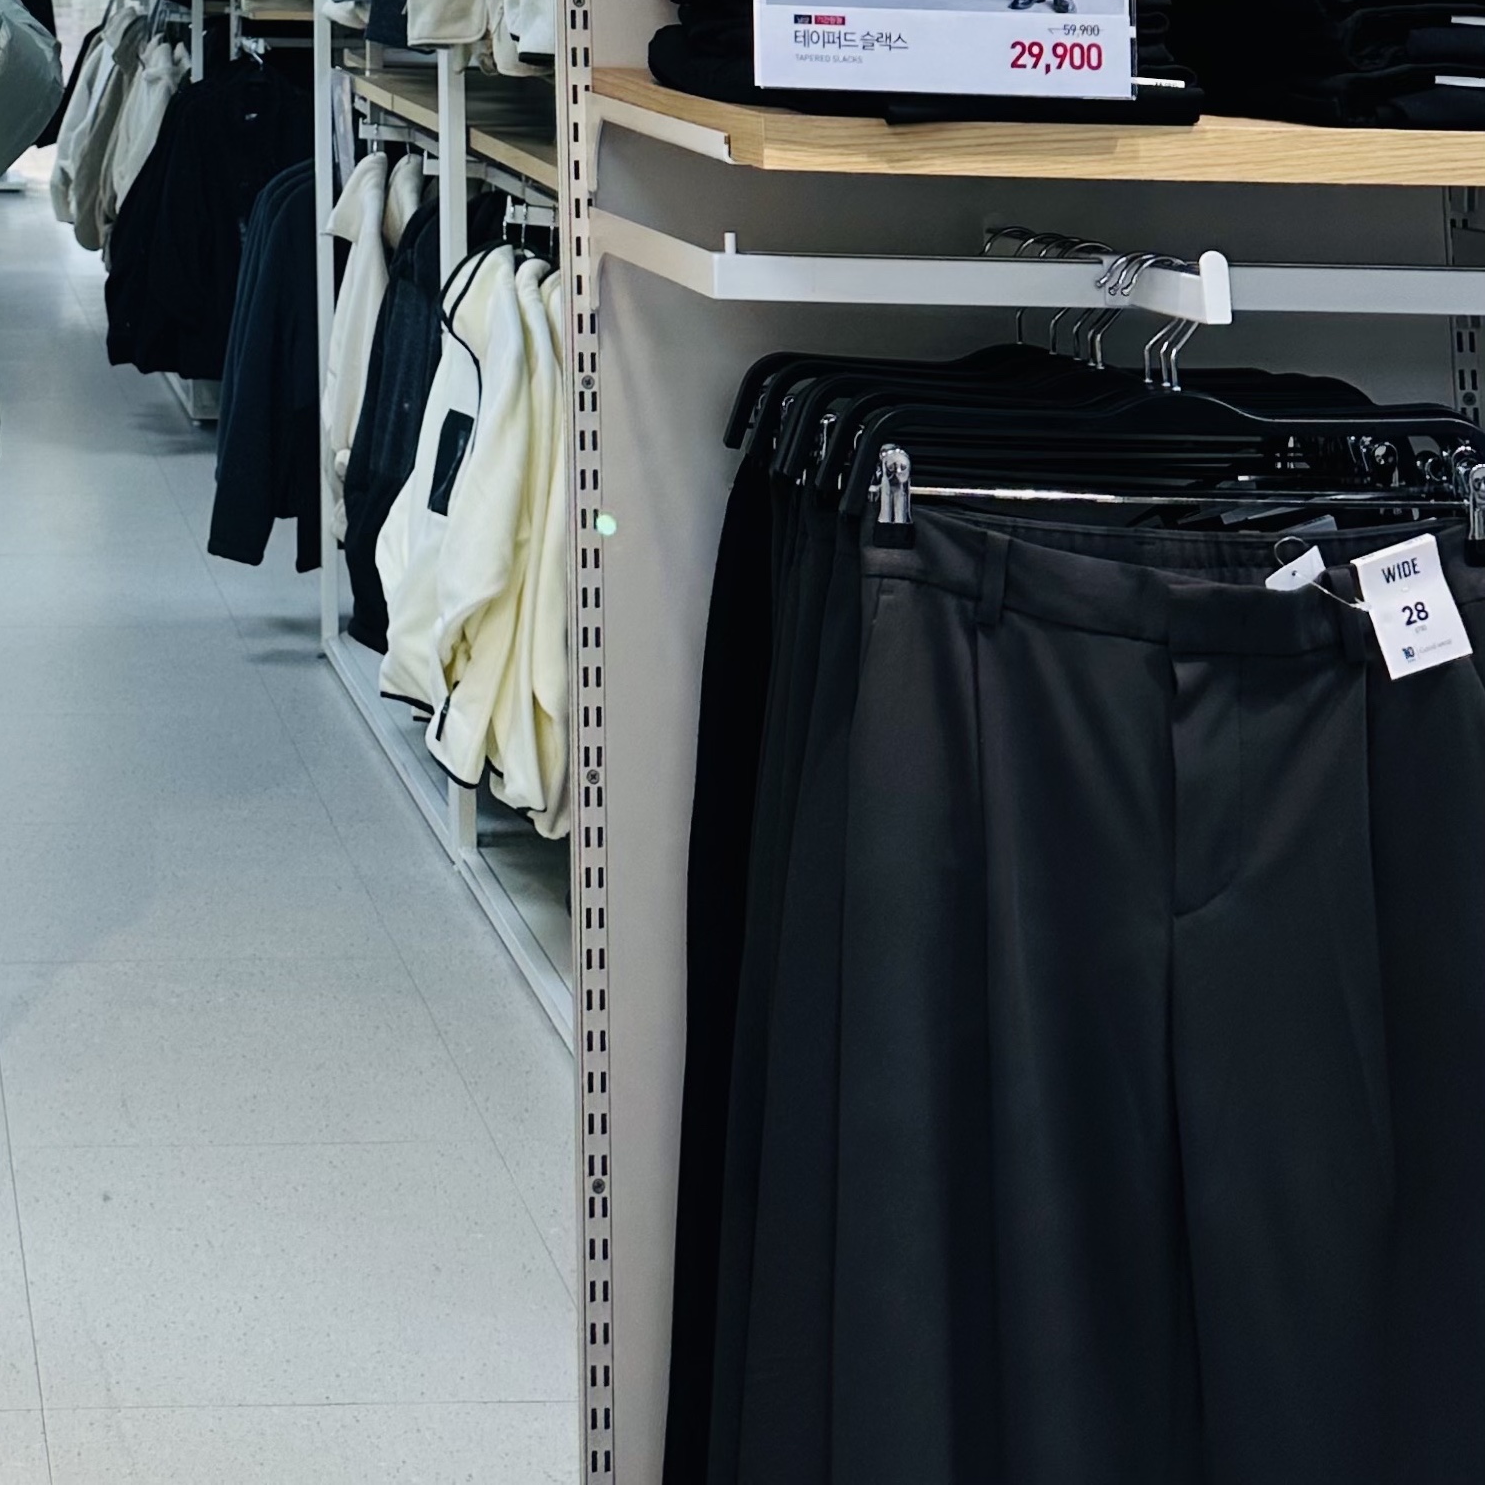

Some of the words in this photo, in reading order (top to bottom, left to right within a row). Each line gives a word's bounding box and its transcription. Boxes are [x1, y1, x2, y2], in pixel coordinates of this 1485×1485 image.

[794, 29, 858, 49] 테이퍼드
[860, 30, 909, 51] 슬랙스
[1010, 41, 1103, 75] 29,900
[1381, 557, 1420, 584] WIDE
[1402, 601, 1429, 626] 28
